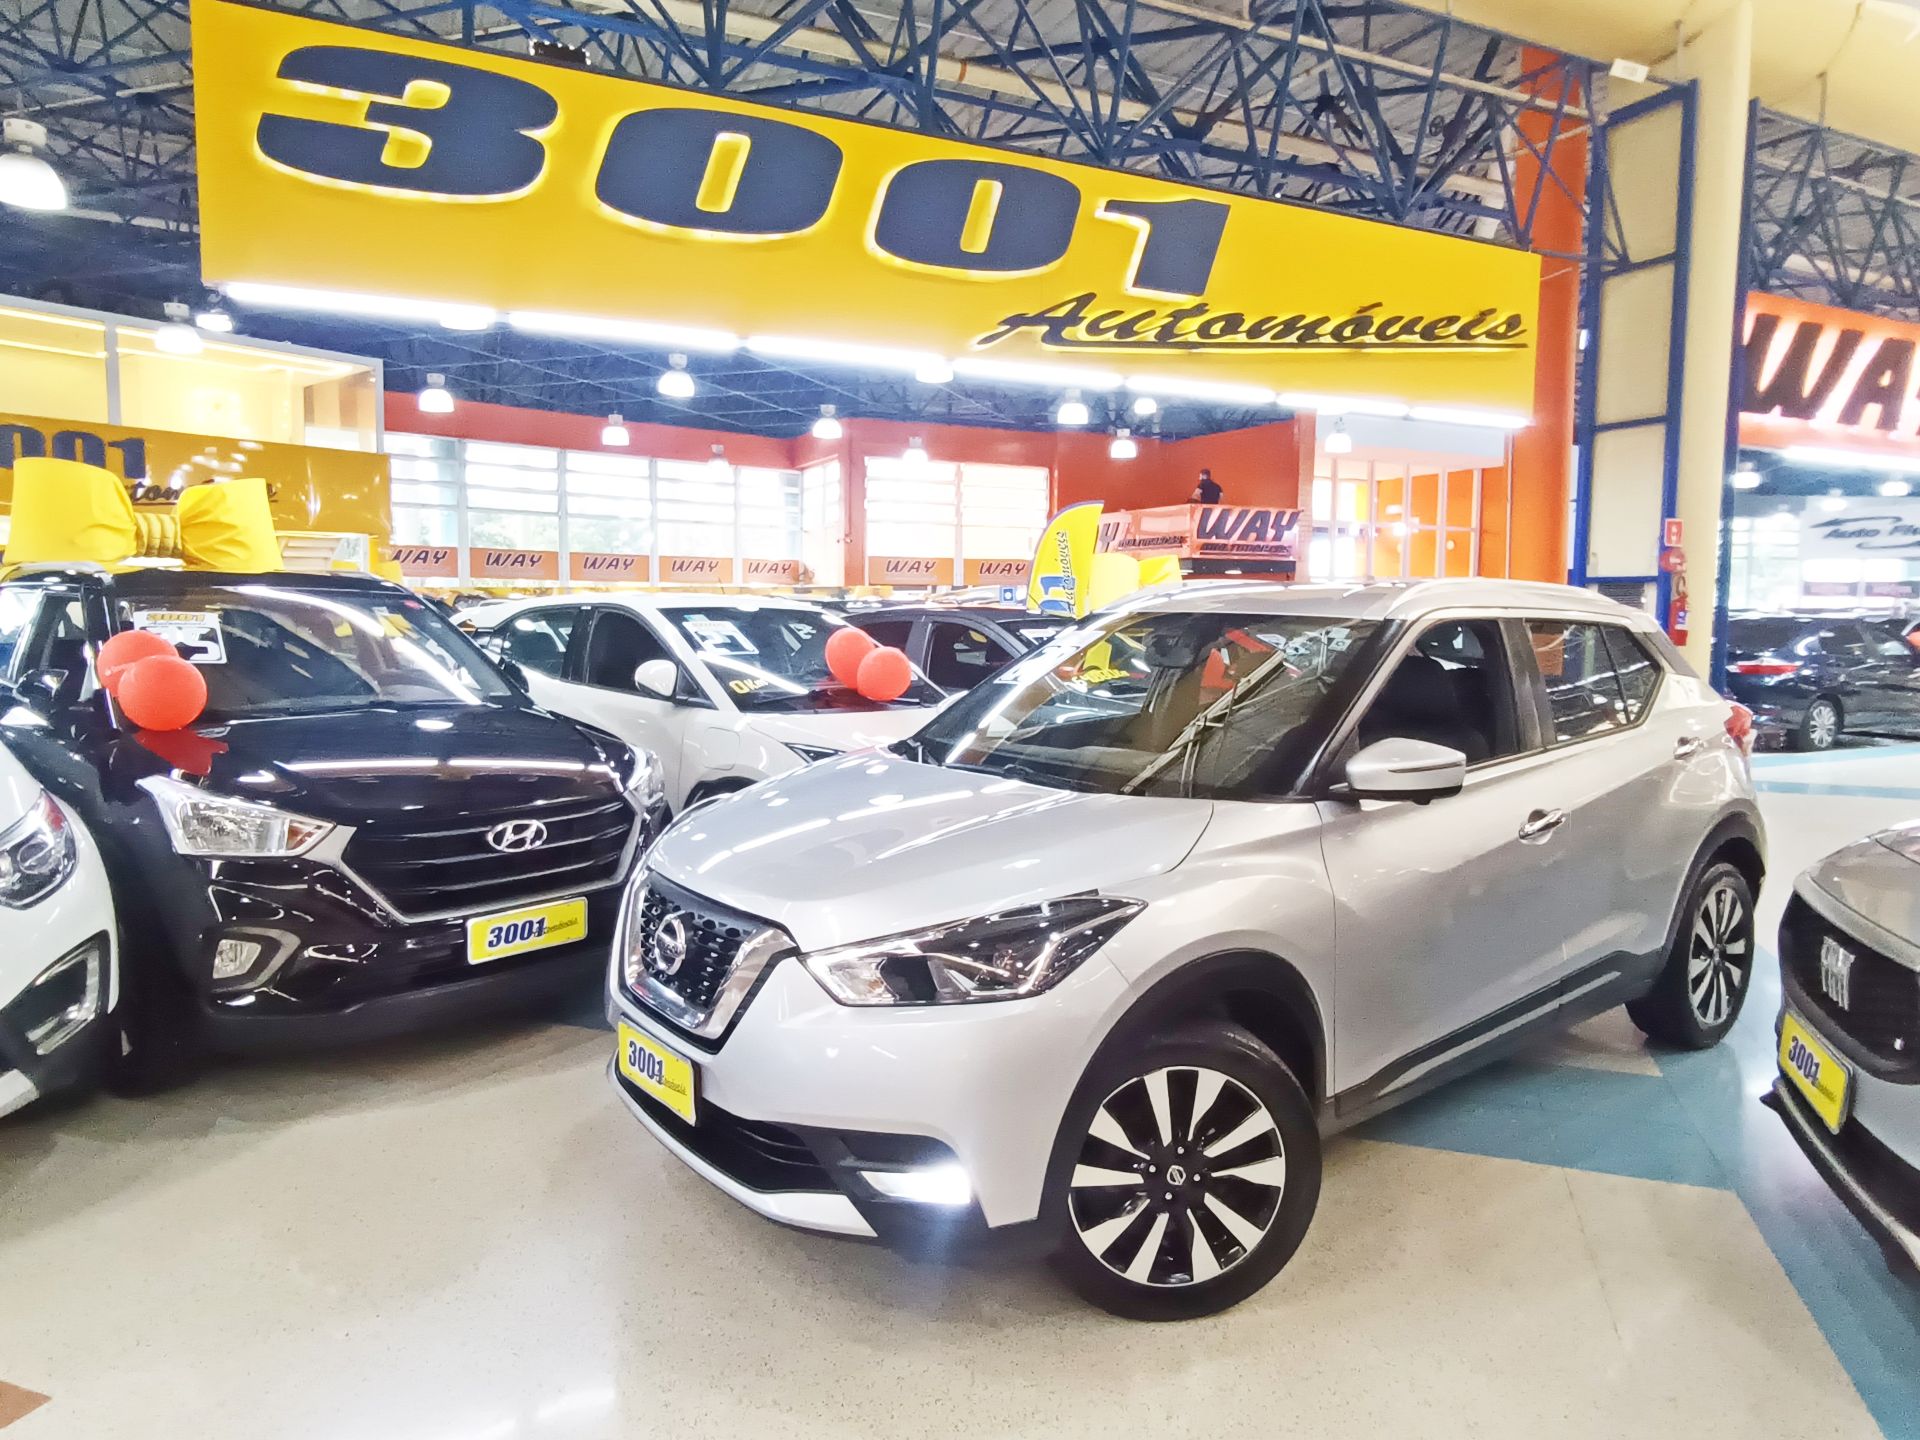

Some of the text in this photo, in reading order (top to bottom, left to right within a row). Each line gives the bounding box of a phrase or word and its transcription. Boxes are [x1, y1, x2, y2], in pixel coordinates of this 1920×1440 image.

[256, 45, 1231, 298] 3001
[976, 291, 1528, 350] Automóveis
[1740, 313, 1920, 437] WA
[1197, 508, 1300, 542] WAY
[485, 552, 543, 567] WAY
[583, 556, 635, 571] WAY
[671, 560, 719, 573] WAY
[747, 562, 792, 575] WAY
[886, 560, 937, 573] WAY
[979, 562, 1026, 575] WAY
[488, 916, 546, 948] 3001
[628, 1040, 664, 1086] 3001
[1788, 1035, 1820, 1087] 3001
